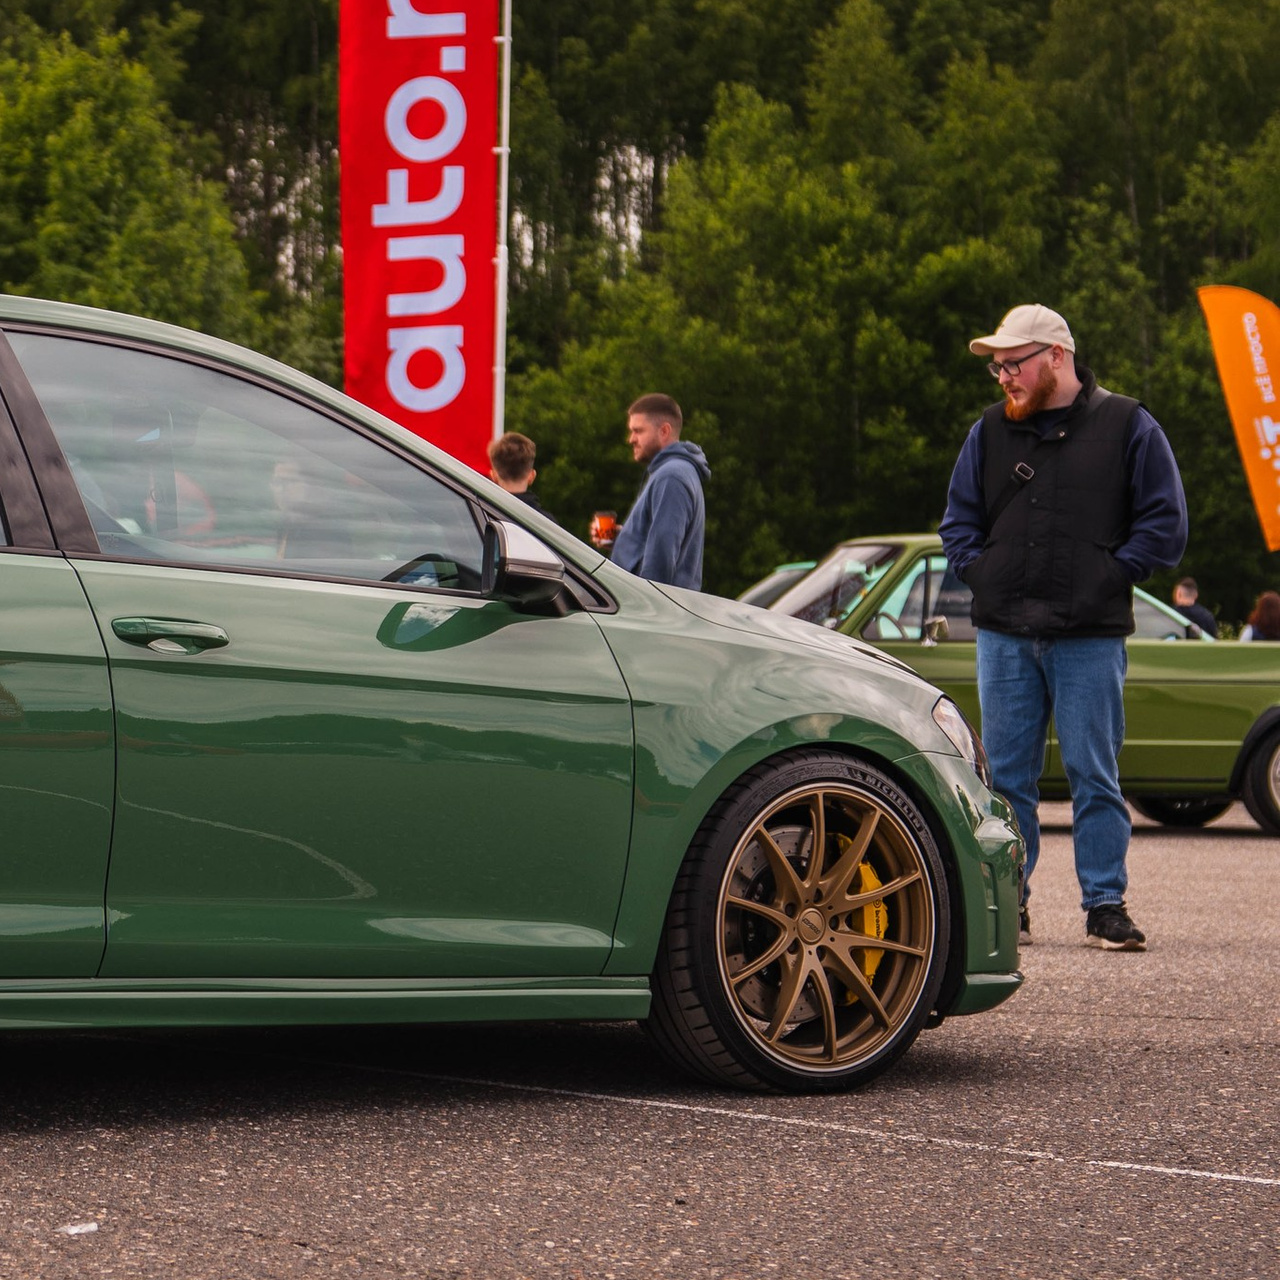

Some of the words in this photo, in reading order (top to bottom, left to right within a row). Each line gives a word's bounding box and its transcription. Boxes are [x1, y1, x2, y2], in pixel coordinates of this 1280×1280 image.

[1243, 312, 1268, 374] ПРОСТО
[1256, 374, 1276, 403] ВСЁ
[865, 774, 922, 830] MICHELIN
